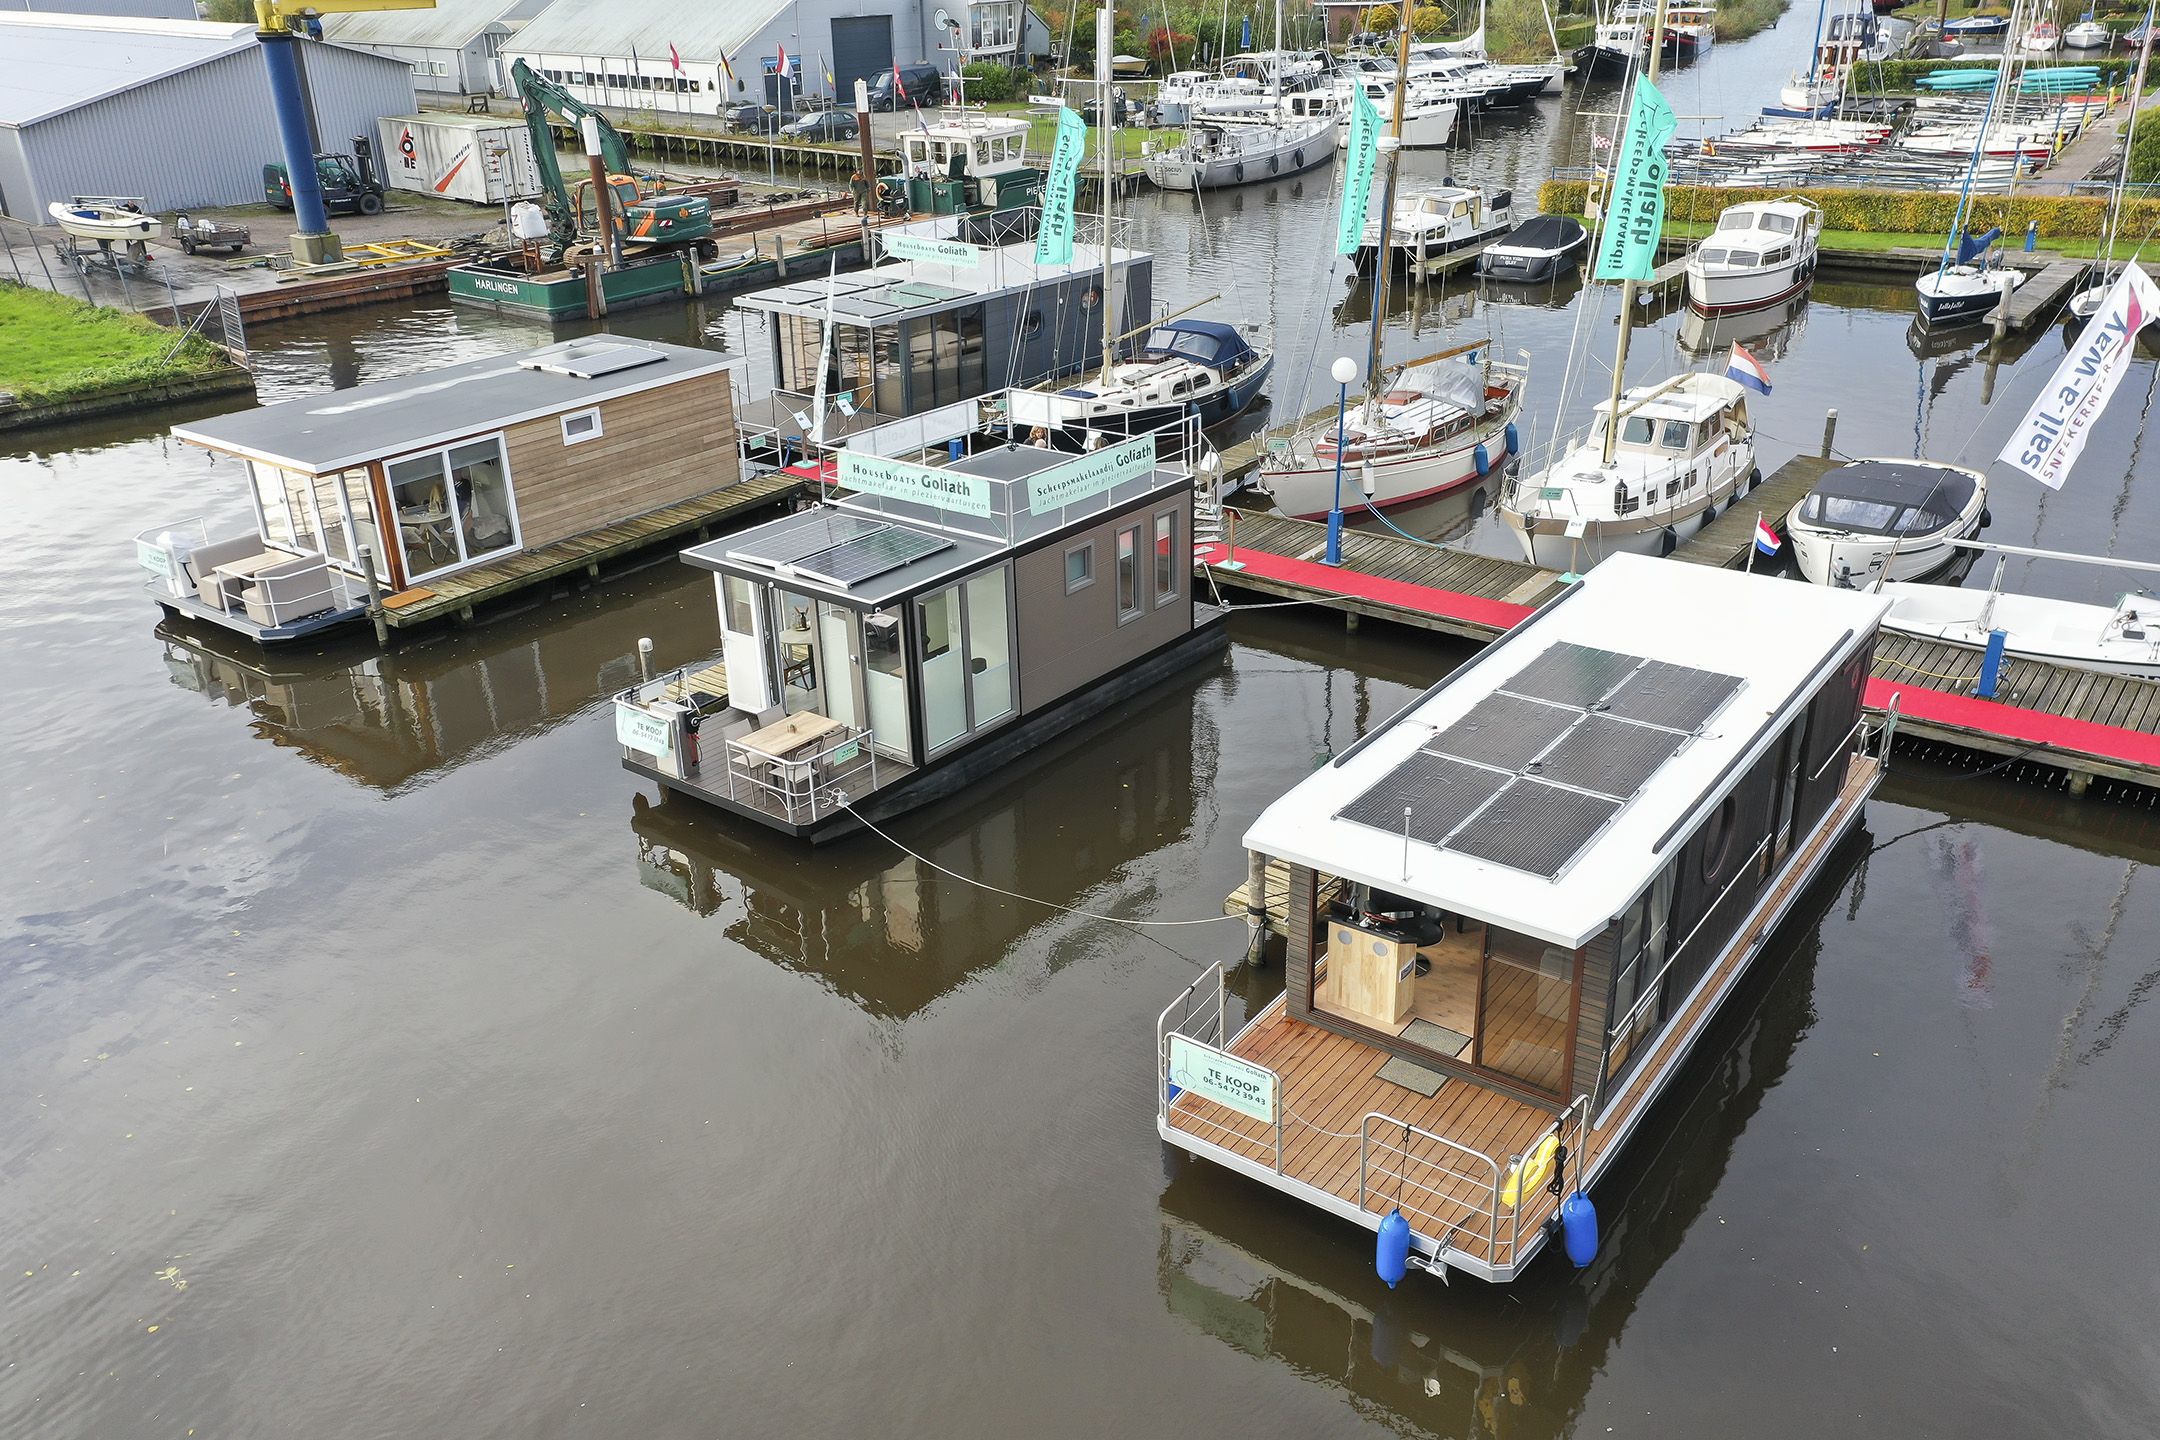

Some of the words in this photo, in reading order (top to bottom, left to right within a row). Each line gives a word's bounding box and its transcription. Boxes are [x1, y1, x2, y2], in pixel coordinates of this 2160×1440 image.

[937, 245, 968, 257] Goliath
[474, 278, 519, 295] HARLINGEN
[2020, 311, 2129, 470] sail-a-way
[2043, 363, 2112, 479] SNEEKERMER
[1115, 444, 1152, 468] Goliath
[840, 474, 897, 492] Jachtmakelaar
[900, 486, 908, 494] in
[911, 488, 987, 511] pleziervaartuigen
[921, 474, 971, 497] Goliath
[1038, 483, 1091, 507] Jachtmakelaar
[637, 722, 644, 731] TE
[645, 725, 663, 736] KOOP
[1208, 1068, 1222, 1081] TE
[1225, 1075, 1260, 1094] KOOP
[1245, 1067, 1267, 1081] Goliath
[1230, 1087, 1241, 1097] 72
[1242, 1091, 1254, 1101] 39
[1255, 1096, 1266, 1106] 43
